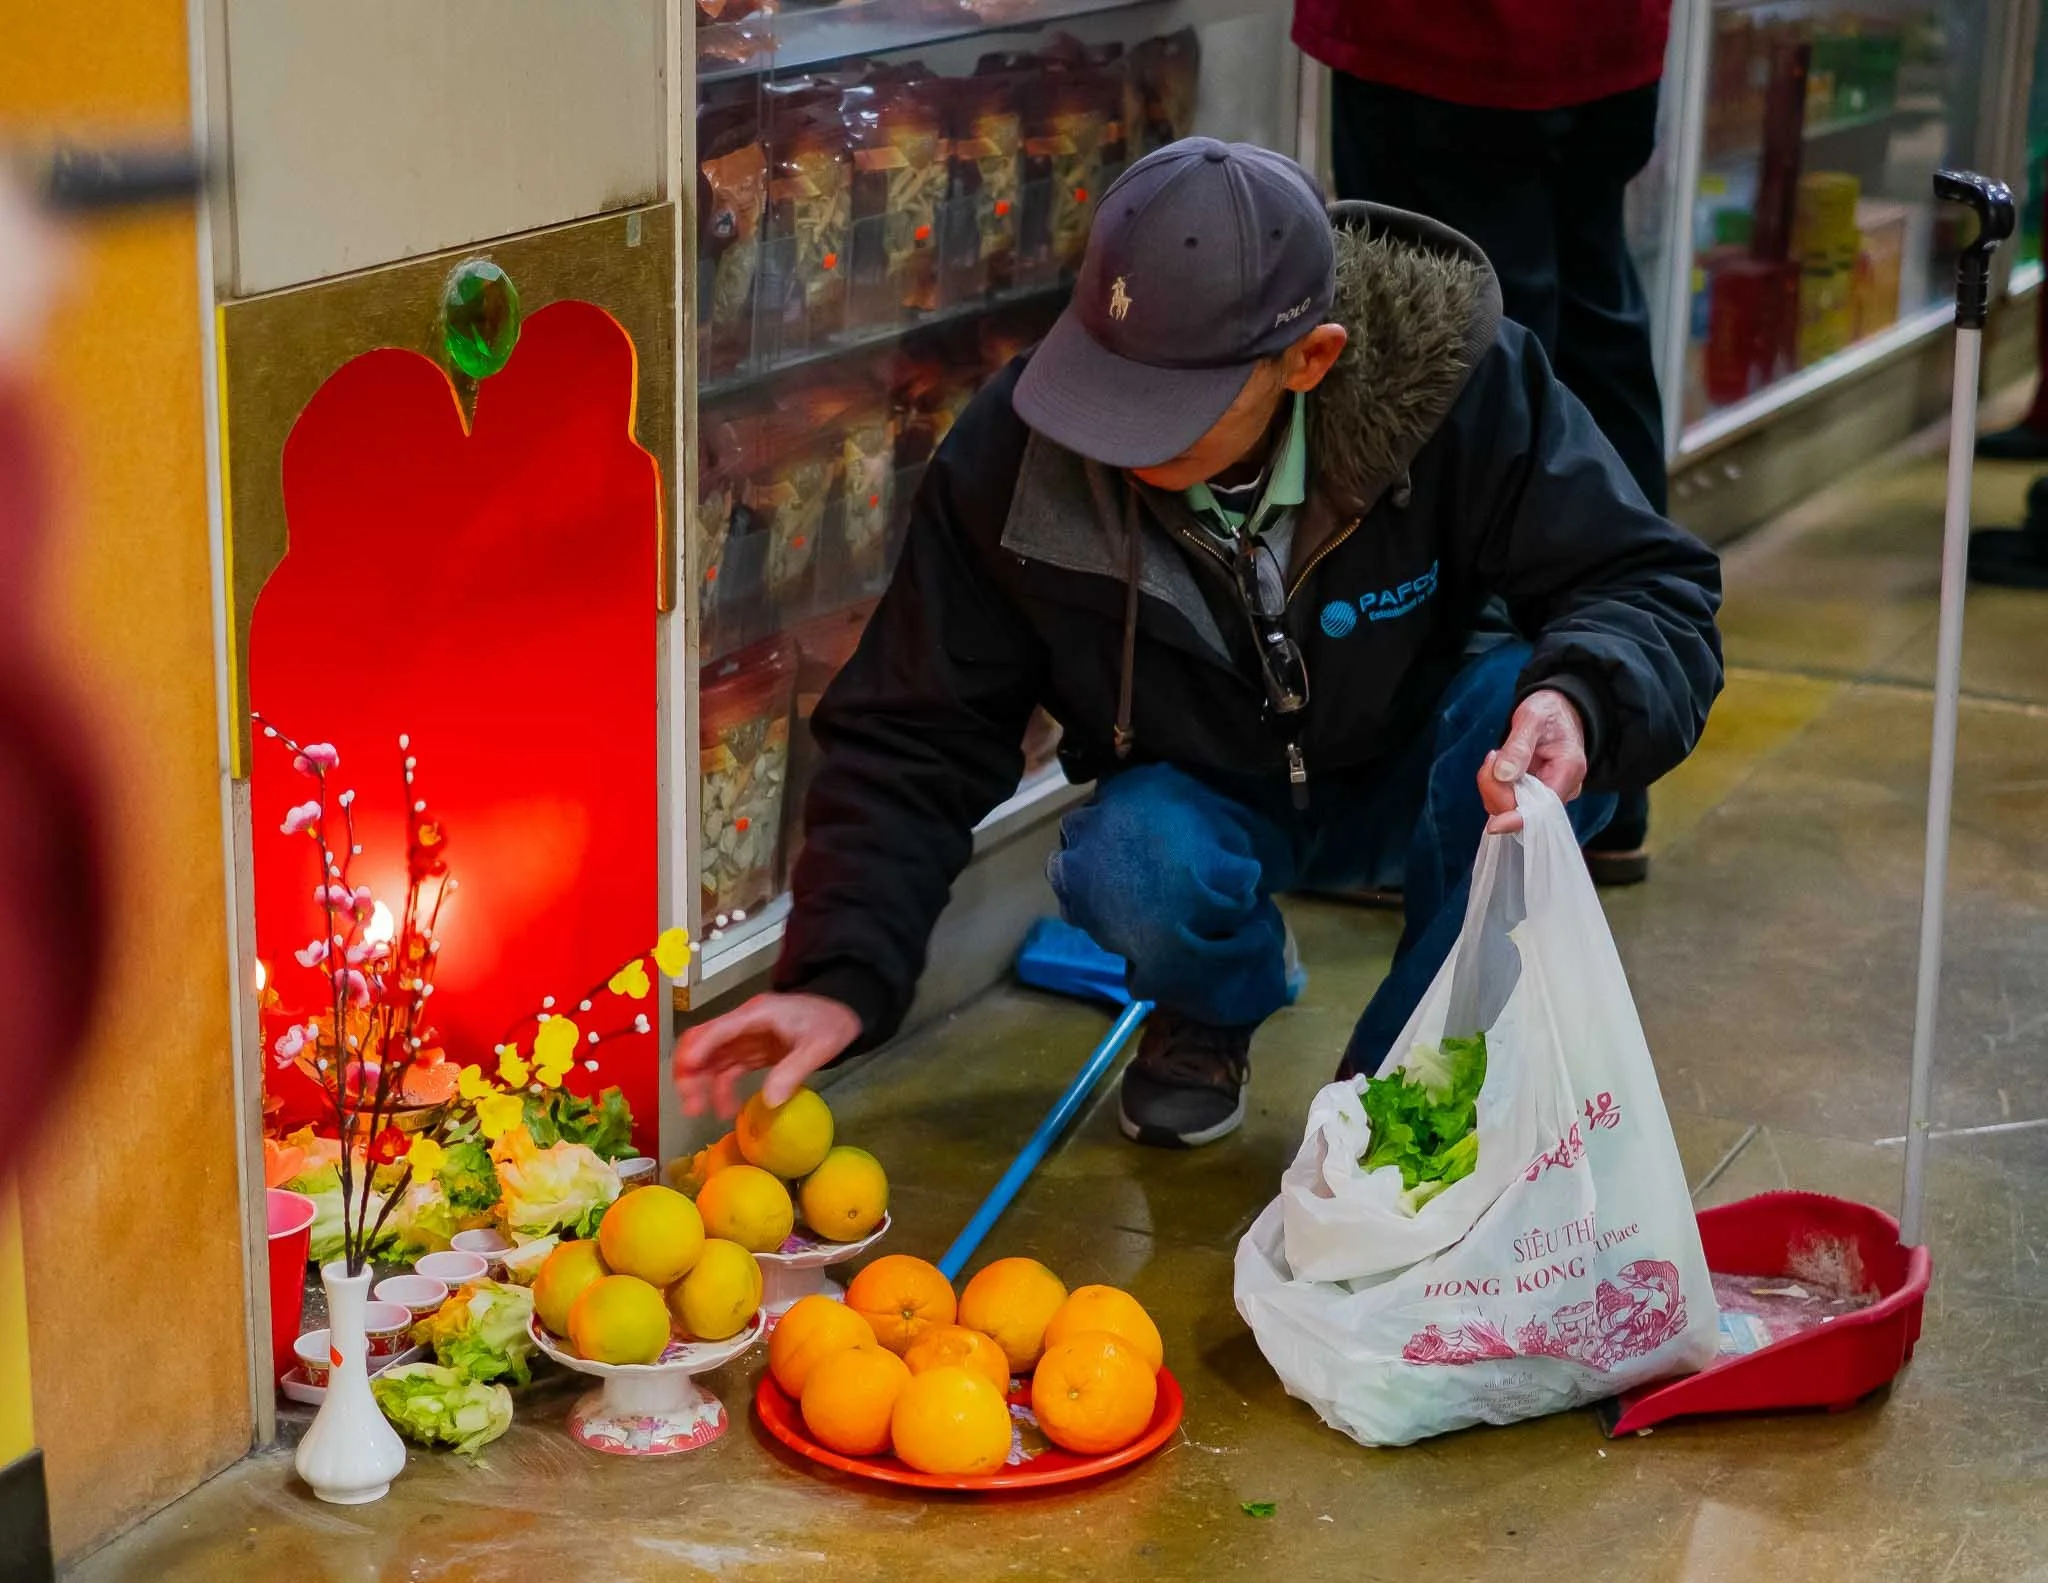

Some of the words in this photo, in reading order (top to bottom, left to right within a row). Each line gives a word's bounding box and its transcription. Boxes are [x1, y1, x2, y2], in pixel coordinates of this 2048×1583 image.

[1275, 296, 1311, 328] POLO
[1602, 1222, 1640, 1249] Place
[1424, 1278, 1500, 1298] HONG
[1515, 1256, 1586, 1294] KONG
